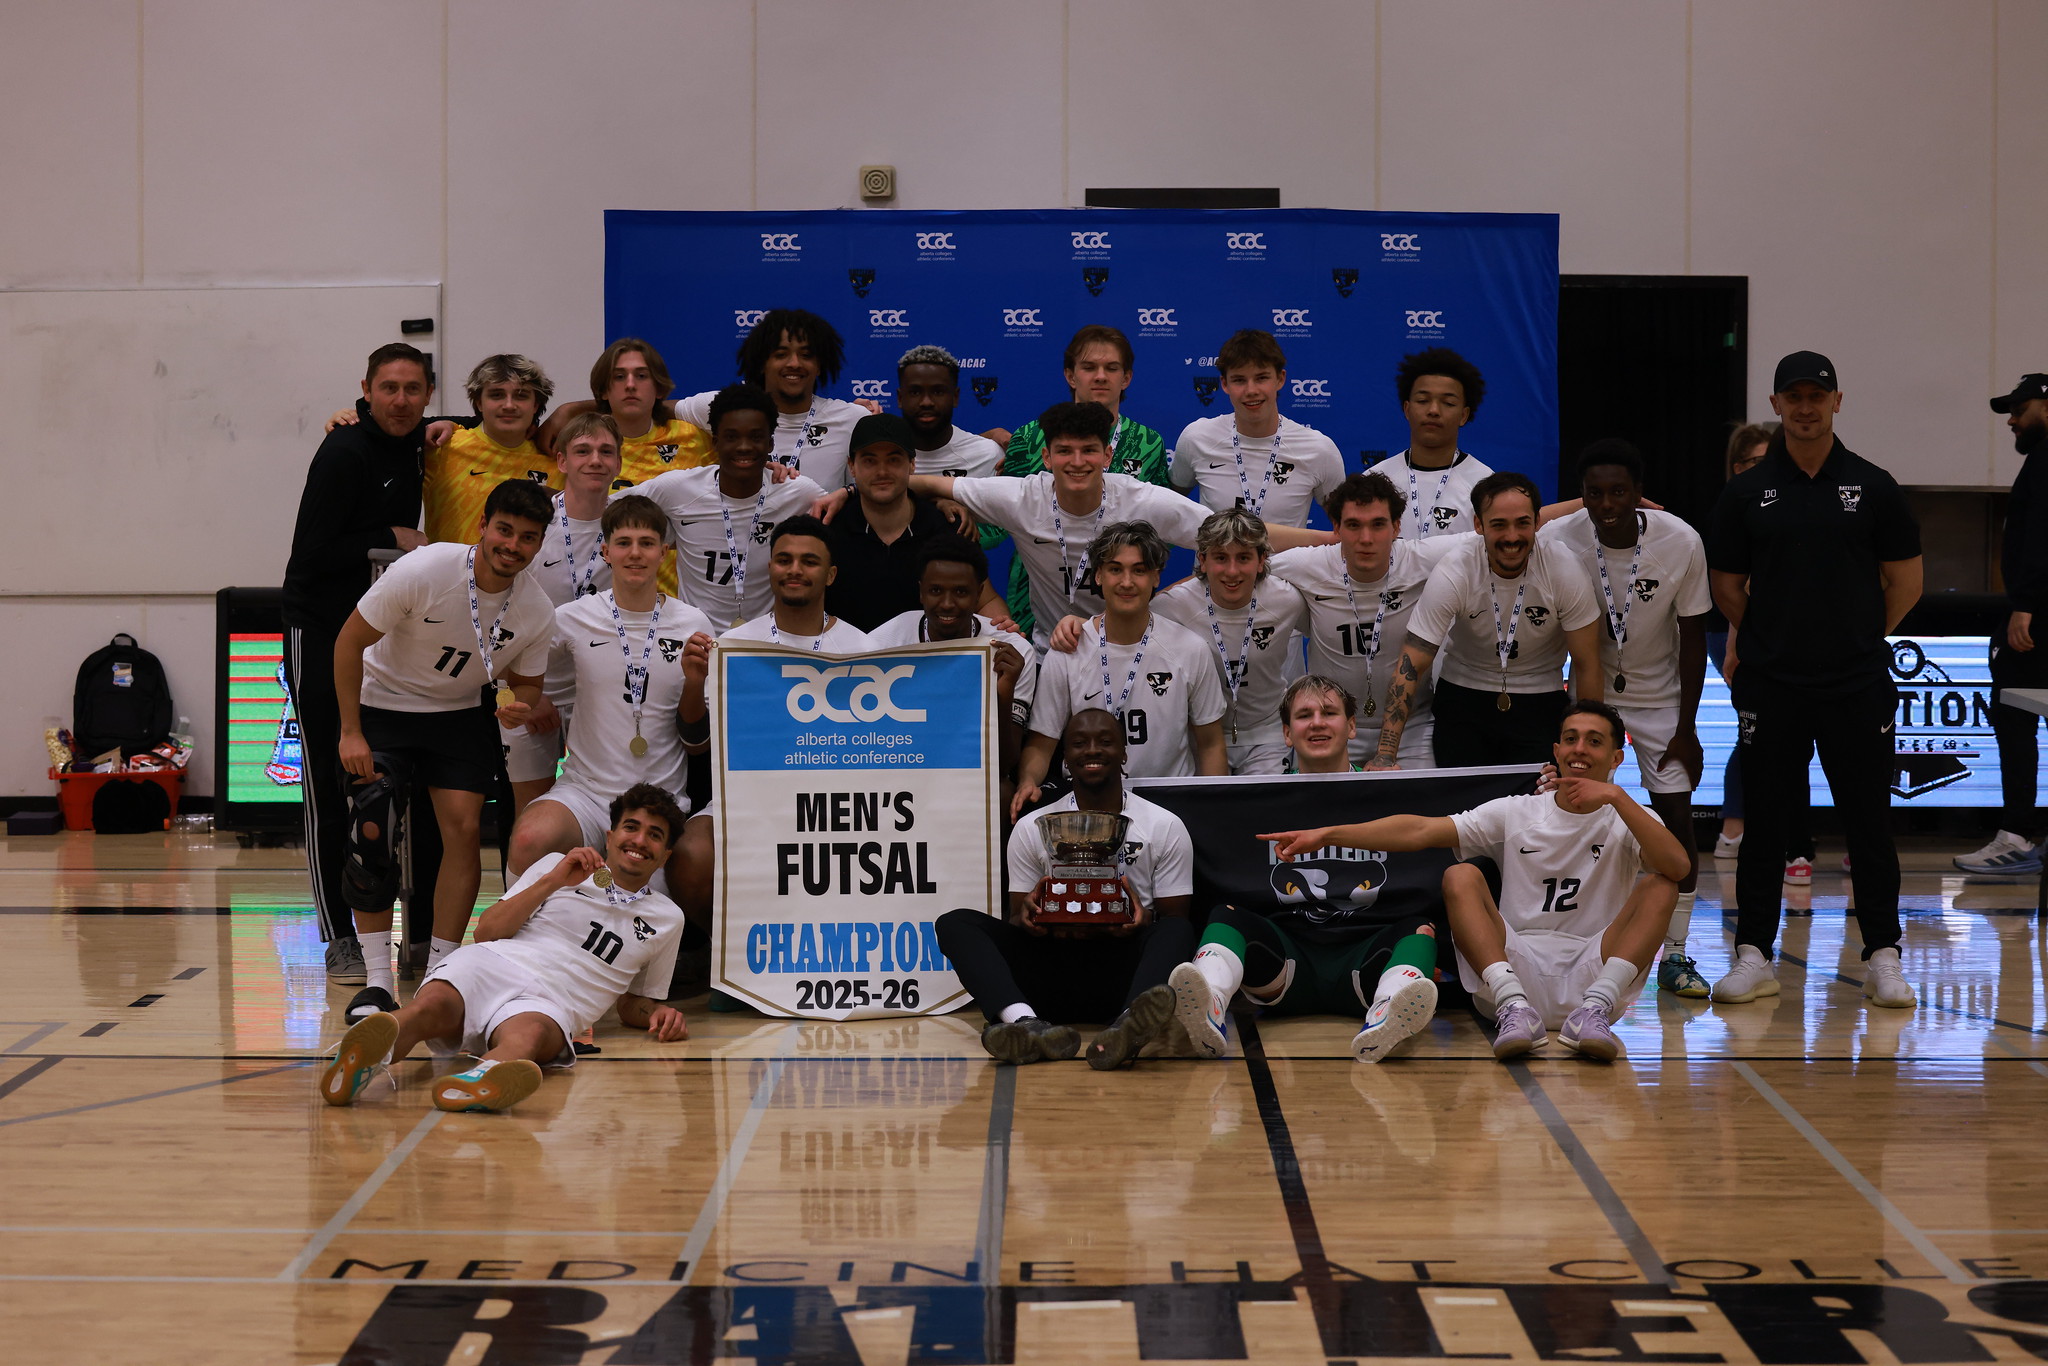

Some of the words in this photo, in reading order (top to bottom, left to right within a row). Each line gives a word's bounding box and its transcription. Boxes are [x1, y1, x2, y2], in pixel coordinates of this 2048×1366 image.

[735, 310, 772, 327] aca
[1763, 489, 1777, 499] DO
[704, 551, 743, 585] 17
[434, 646, 472, 678] 11
[781, 664, 927, 723] acac
[796, 733, 846, 746] alberta
[851, 732, 913, 749] colleges
[784, 751, 838, 765] athletic
[841, 751, 924, 765] conference
[796, 791, 915, 832] MEN'S
[777, 841, 937, 896] FUTSAL
[1542, 877, 1581, 912] 12
[581, 921, 623, 965] 10
[796, 979, 919, 1010] 2025-26
[329, 1259, 1075, 1283] MEDICINE
[1171, 1260, 1457, 1283] HAT
